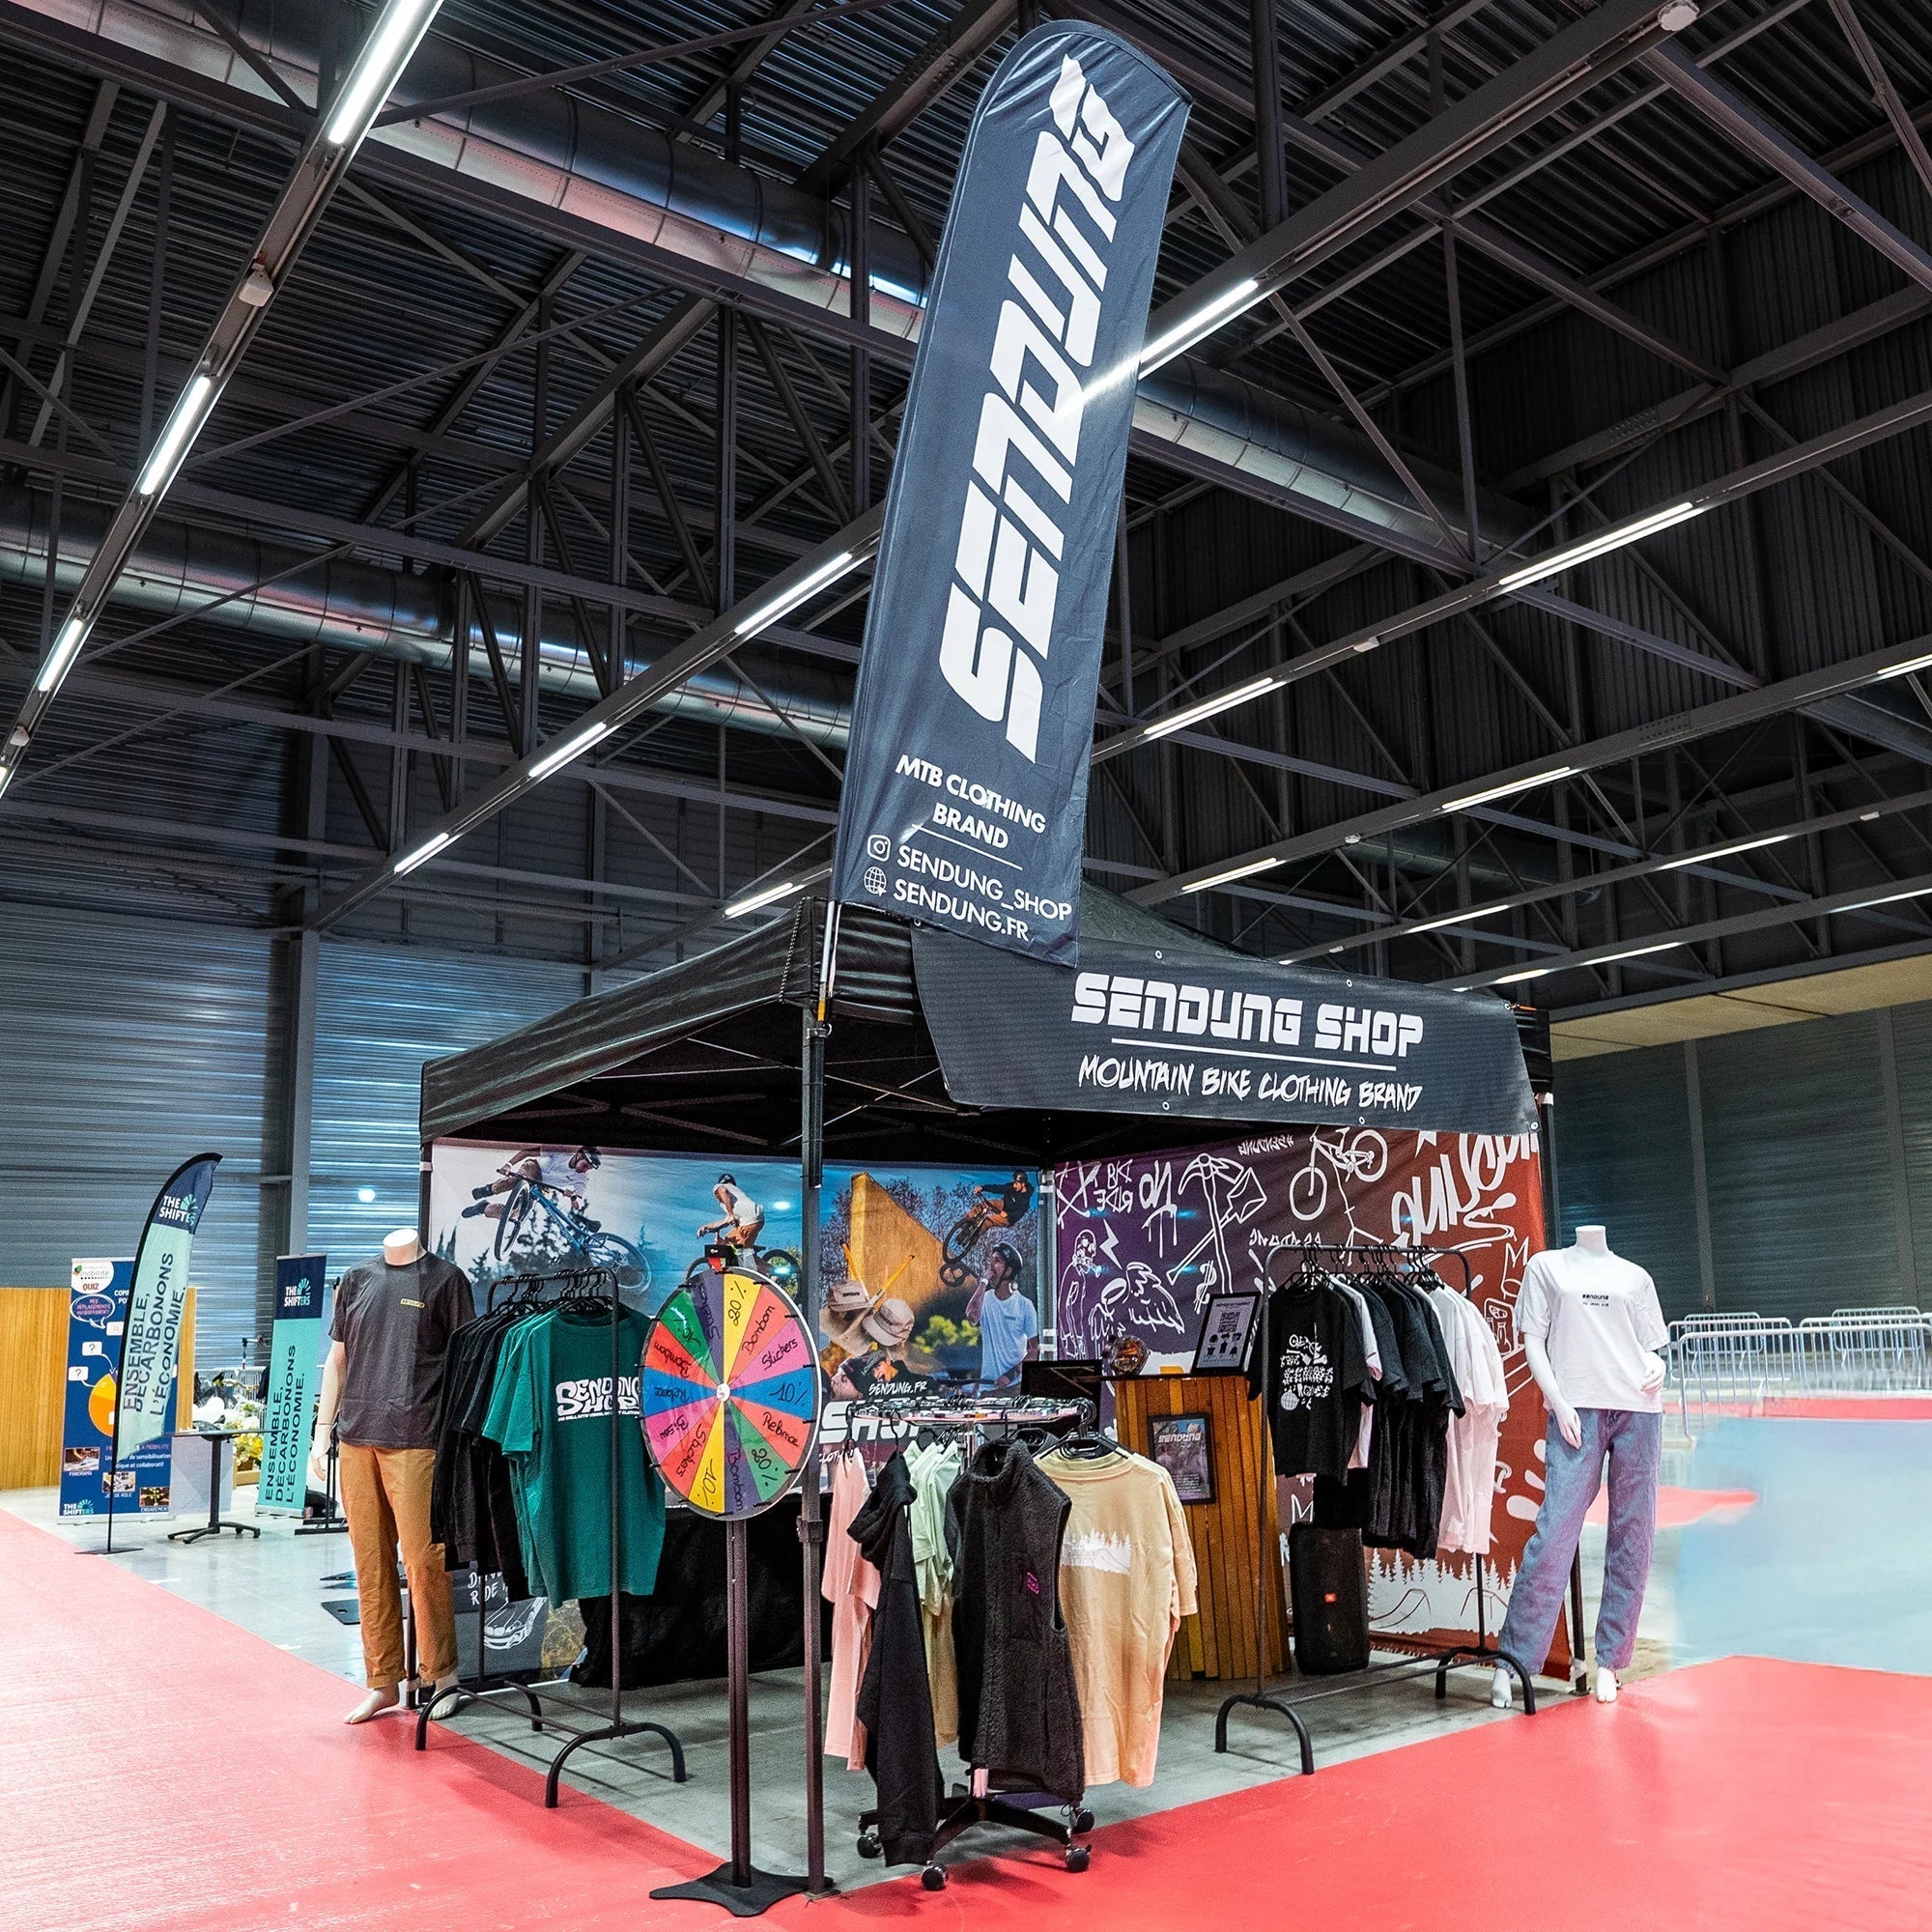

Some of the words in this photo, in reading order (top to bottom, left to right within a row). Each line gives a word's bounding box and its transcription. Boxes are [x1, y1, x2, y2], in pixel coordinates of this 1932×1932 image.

[939, 53, 1135, 764] SENDUNG
[895, 754, 943, 788] MTB
[946, 774, 1046, 834] CLOTHING
[932, 803, 1009, 849] BRAND
[894, 879, 1029, 942] SENDUNG.FR
[896, 844, 1072, 921] SENDUNG_SHOP
[1071, 972, 1303, 1046] SENDUNG
[1315, 1003, 1424, 1058] SHOP
[1078, 1054, 1194, 1095] MOUNTAIN
[1201, 1066, 1251, 1100] BIKE
[1258, 1072, 1351, 1106] CLOTHING
[1358, 1081, 1423, 1112] BRAND
[163, 1195, 181, 1209] THE
[284, 1295, 311, 1307] SHIFTERS
[285, 1286, 298, 1296] THE
[124, 1293, 151, 1410] ENSEMBLE,
[150, 1287, 186, 1416] L'ÉCONOMIE.
[761, 1337, 798, 1371] Stickers
[868, 1381, 927, 1396] SENDUNG.FR
[265, 1386, 284, 1500] ENSEMBLE,
[275, 1345, 297, 1502] DÉCARBONONS
[286, 1373, 305, 1503] L'ÉCONOMIE.
[675, 1429, 706, 1478] Stickers
[470, 1582, 499, 1605] RDE
